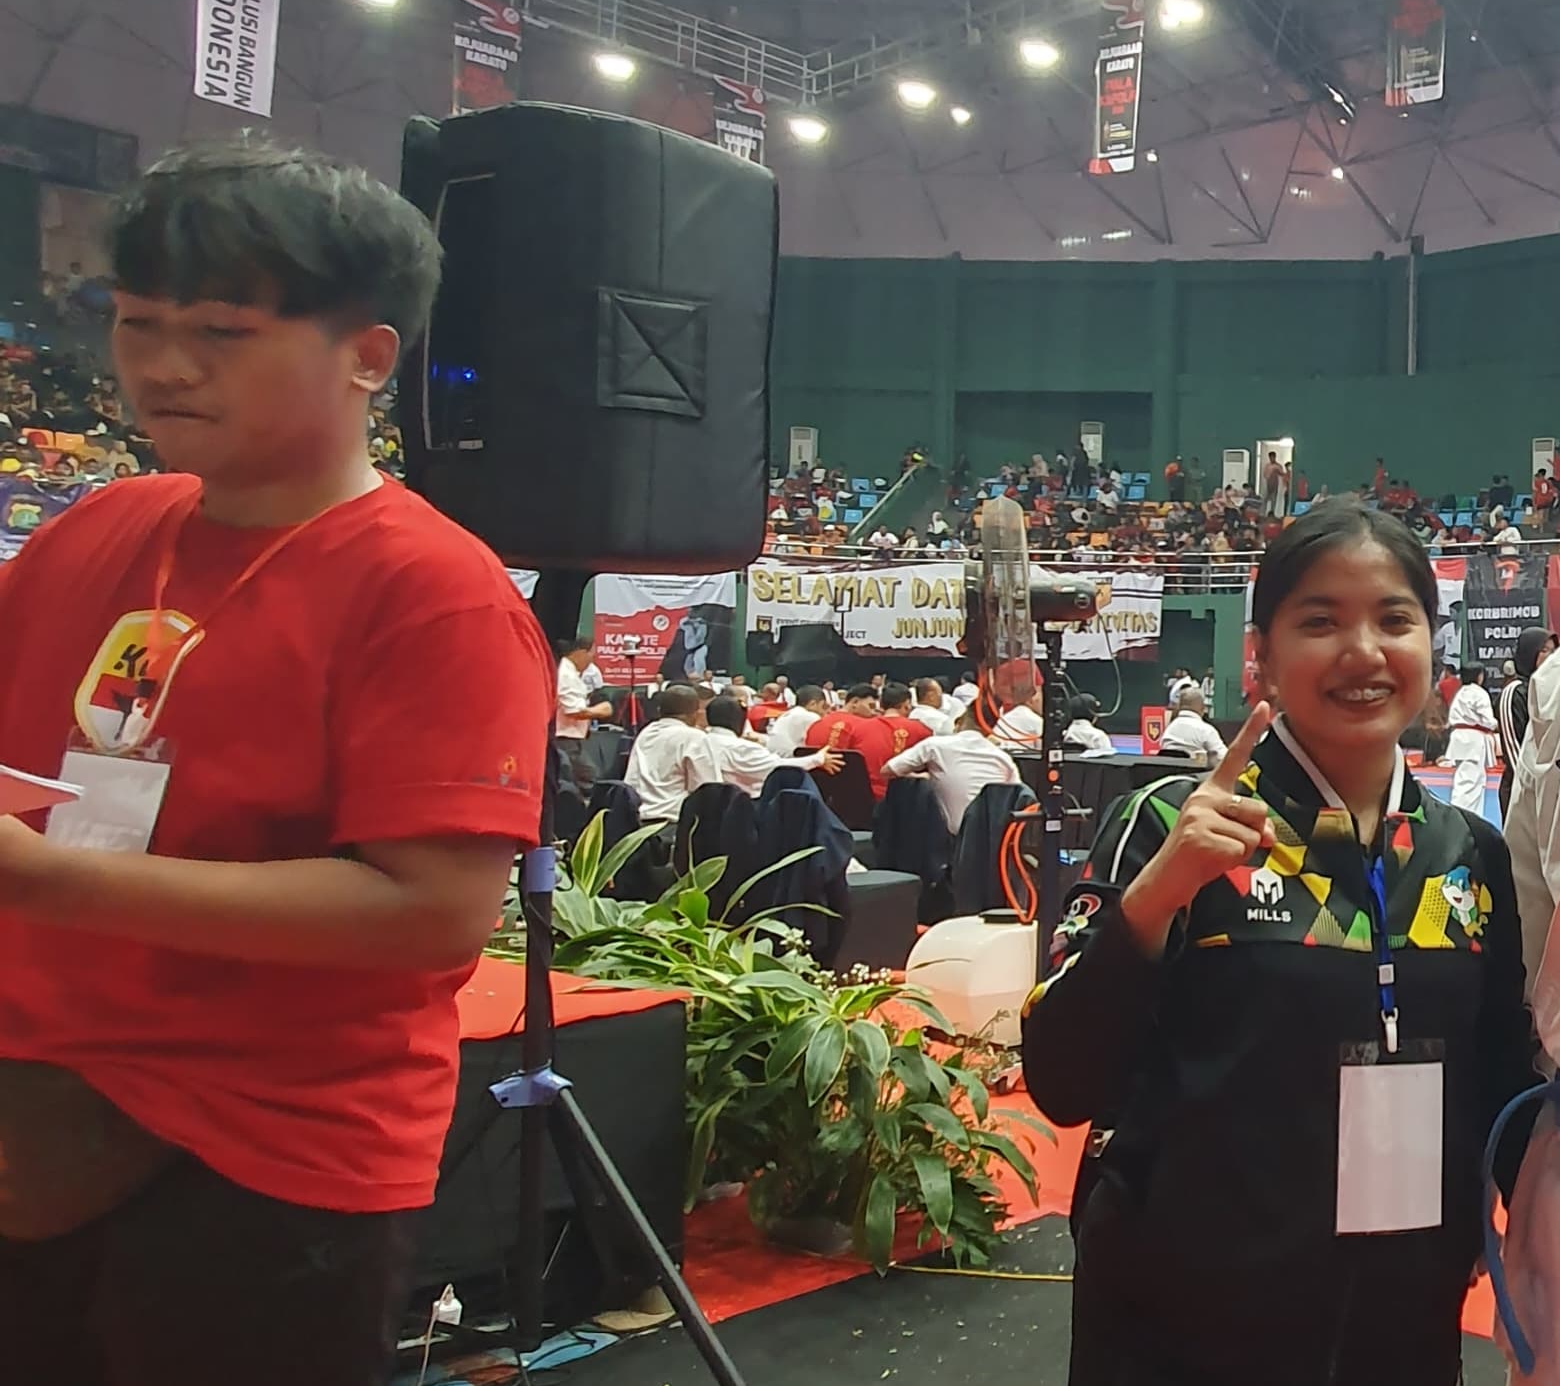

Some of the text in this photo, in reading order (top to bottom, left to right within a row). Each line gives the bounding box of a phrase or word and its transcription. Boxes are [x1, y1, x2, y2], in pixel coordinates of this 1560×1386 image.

[233, 36, 257, 108] BANGUN
[751, 570, 902, 609] SELAMAT
[892, 617, 965, 640] JUNJUN
[1246, 908, 1292, 923] MILLS
